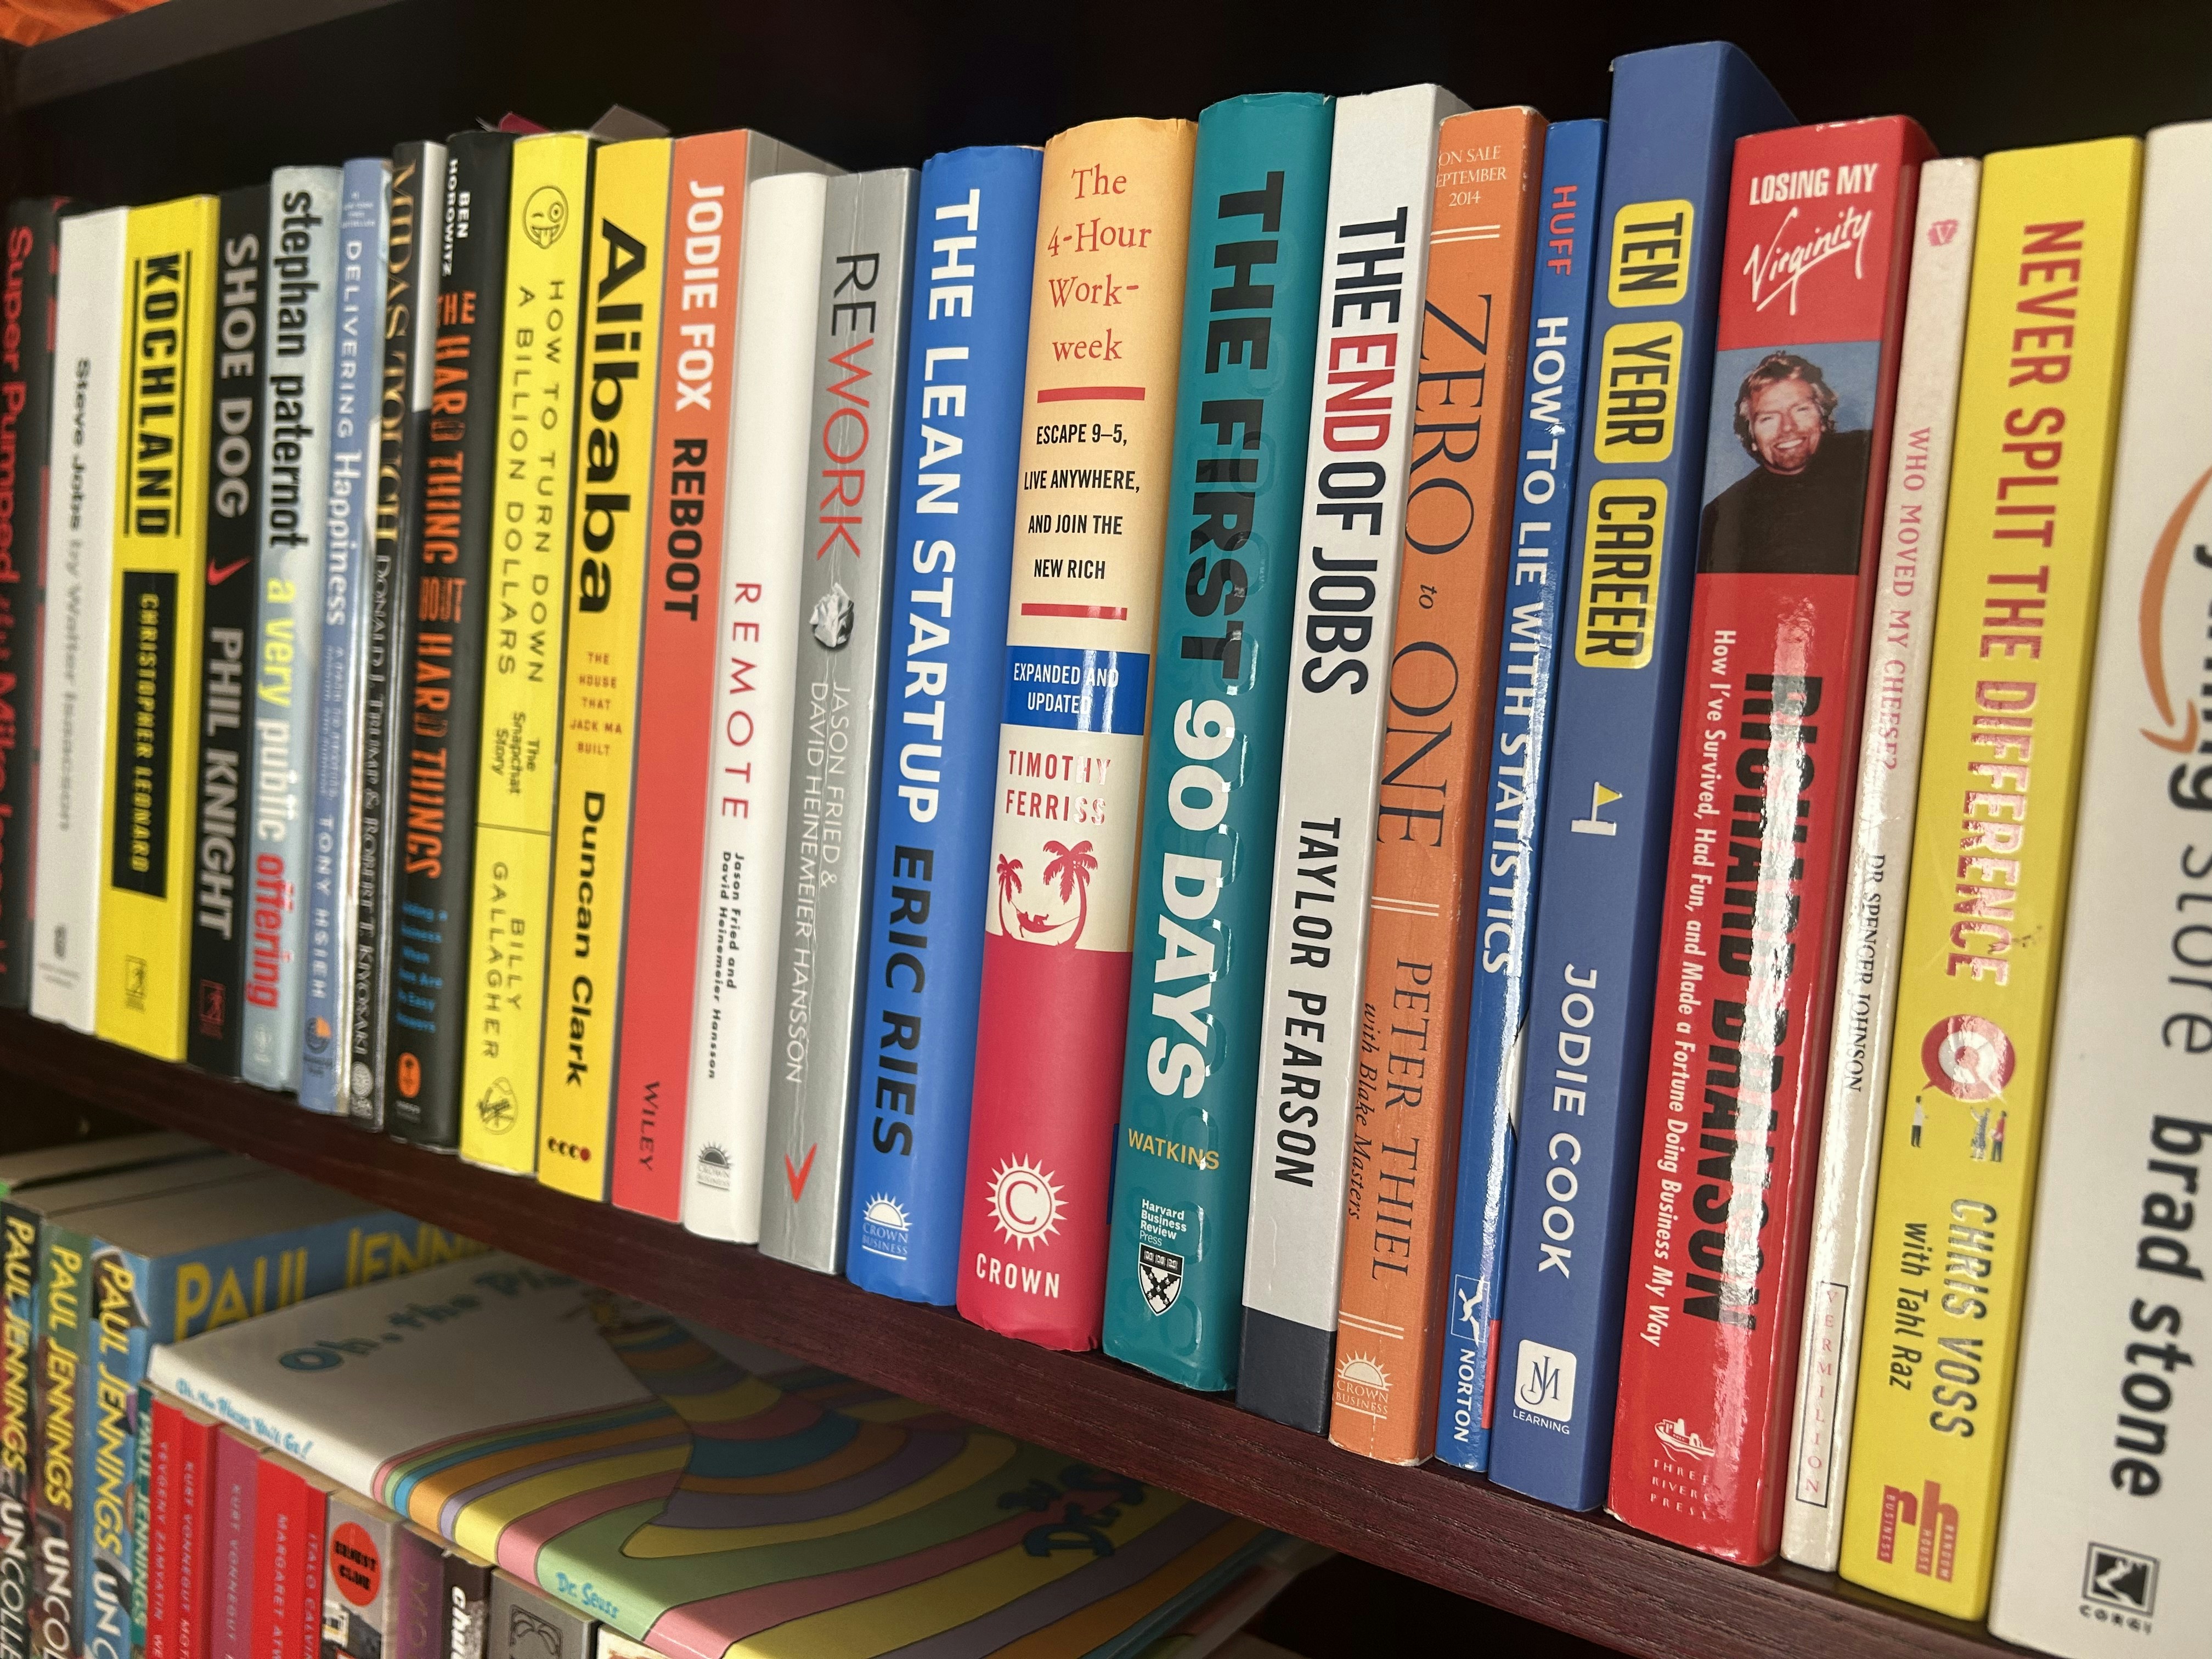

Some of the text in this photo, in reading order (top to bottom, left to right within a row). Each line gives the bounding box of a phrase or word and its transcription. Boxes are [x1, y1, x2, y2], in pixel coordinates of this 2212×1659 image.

[1071, 163, 1127, 200] The
[1438, 145, 1502, 166] ON SALE
[1448, 190, 1482, 207] 2014
[1748, 163, 1879, 206] LOSING MY
[456, 191, 471, 238] BEN
[1047, 218, 1152, 257] 4-Hour
[1547, 184, 1578, 276] HUFF
[1, 226, 33, 371] Super
[675, 180, 725, 412] JODIE FOX
[1048, 273, 1139, 308] Work-
[1743, 206, 1872, 316] Virginity
[216, 234, 259, 519] SHOE DOG
[268, 190, 321, 549] stephan paternot
[336, 240, 363, 438] DELIVERING
[1052, 328, 1122, 362] week
[74, 358, 92, 448] Steve
[135, 251, 181, 537] KOCHLAND
[579, 217, 647, 613] Alibaba
[816, 252, 880, 561] REWORK
[1180, 171, 1285, 681] THE FIRST
[1584, 212, 1684, 658] TEN YEAR CAREER
[70, 454, 86, 531] Jobs
[497, 285, 537, 675] A BILLION DOLLARS
[528, 279, 565, 683] HOW TO TURN DOWN
[1024, 469, 1141, 493] LIVE ANYWHERE,
[1301, 206, 1408, 696] THE END OF JOBS
[326, 450, 363, 626] Happiness
[664, 438, 708, 622] REBOOT
[896, 188, 980, 825] THE LEAN STARTUP
[1028, 515, 1123, 535] AND JOIN THE
[1034, 558, 1105, 579] NEW RICH
[1376, 294, 1492, 848] ZERO to ONE
[1877, 426, 1931, 771] WHO MOVED MY CHEESE?
[1946, 219, 2086, 986] NEVER SPLIT THE DIFFERENCE
[1013, 662, 1119, 689] EXPANDED AND
[1711, 629, 1736, 676] How
[130, 592, 159, 873] CHRISTOPHER LEONARD
[569, 719, 623, 734] JACK MA
[722, 582, 763, 820] REMOTE
[1027, 691, 1091, 715] UPDATED
[199, 627, 244, 940] PHIL KNIGHT
[245, 578, 297, 1009] a very public offering
[820, 682, 850, 887] JASON FRIED &
[1006, 789, 1106, 826] FERRISS
[1009, 749, 1111, 786] TIMOTHY
[1693, 730, 1727, 821] Survived,
[316, 817, 334, 896] TONY
[786, 682, 829, 1084] DAVID HEINEMEIER HANSSON
[1691, 828, 1717, 867] Had
[565, 791, 606, 1087] Duncan Clark
[1147, 698, 1236, 1099] 90 DAYS
[1683, 874, 1712, 914] Fun,
[1683, 919, 1707, 957] and
[311, 907, 329, 1000] HSIEH
[483, 861, 509, 1060] GALLAGHER
[506, 917, 525, 1012] BILLY
[1675, 962, 1703, 1014] Made
[872, 844, 935, 1159] ERIC RIES
[1274, 817, 1341, 1189] TAYLOR PEARSON
[1675, 1020, 1688, 1034] a
[1682, 673, 1824, 1331] RICHARD BRANSON
[1348, 1002, 1378, 1221] with Blake Masters
[1371, 957, 1434, 1280] PETER THIEL
[1537, 963, 1598, 1279] JODIE COOK
[1668, 1039, 1696, 1113] Fortune
[637, 1080, 661, 1173] WILEY
[1127, 1128, 1220, 1171] WATKINS
[1656, 1119, 1688, 1175] Doing
[862, 1222, 909, 1244] CROWN
[1139, 1229, 1163, 1246] Press
[1140, 1219, 1177, 1240] Review
[1141, 1209, 1187, 1232] Business
[1142, 1198, 1184, 1221] Harvard
[1654, 1179, 1683, 1260] Business
[976, 1252, 1060, 1299] CROWN
[1645, 1265, 1673, 1298] My
[1888, 1222, 1933, 1391] with Tahl Raz
[1929, 1198, 1997, 1438] CHRIS VOSS
[2109, 1114, 2212, 1499] brad stone
[1639, 1302, 1671, 1348] Way
[44, 1244, 82, 1511] PAUL JENNINGS
[93, 1260, 135, 1556] PAUL JENNINGS
[1336, 1380, 1389, 1404] CROWN
[1453, 1348, 1476, 1443] NORTON
[1513, 1408, 1571, 1435] LEARNING
[1653, 1458, 1709, 1486] THREE
[555, 1571, 620, 1620] Dr. Seuss
[2079, 1603, 2153, 1637] CORGI
